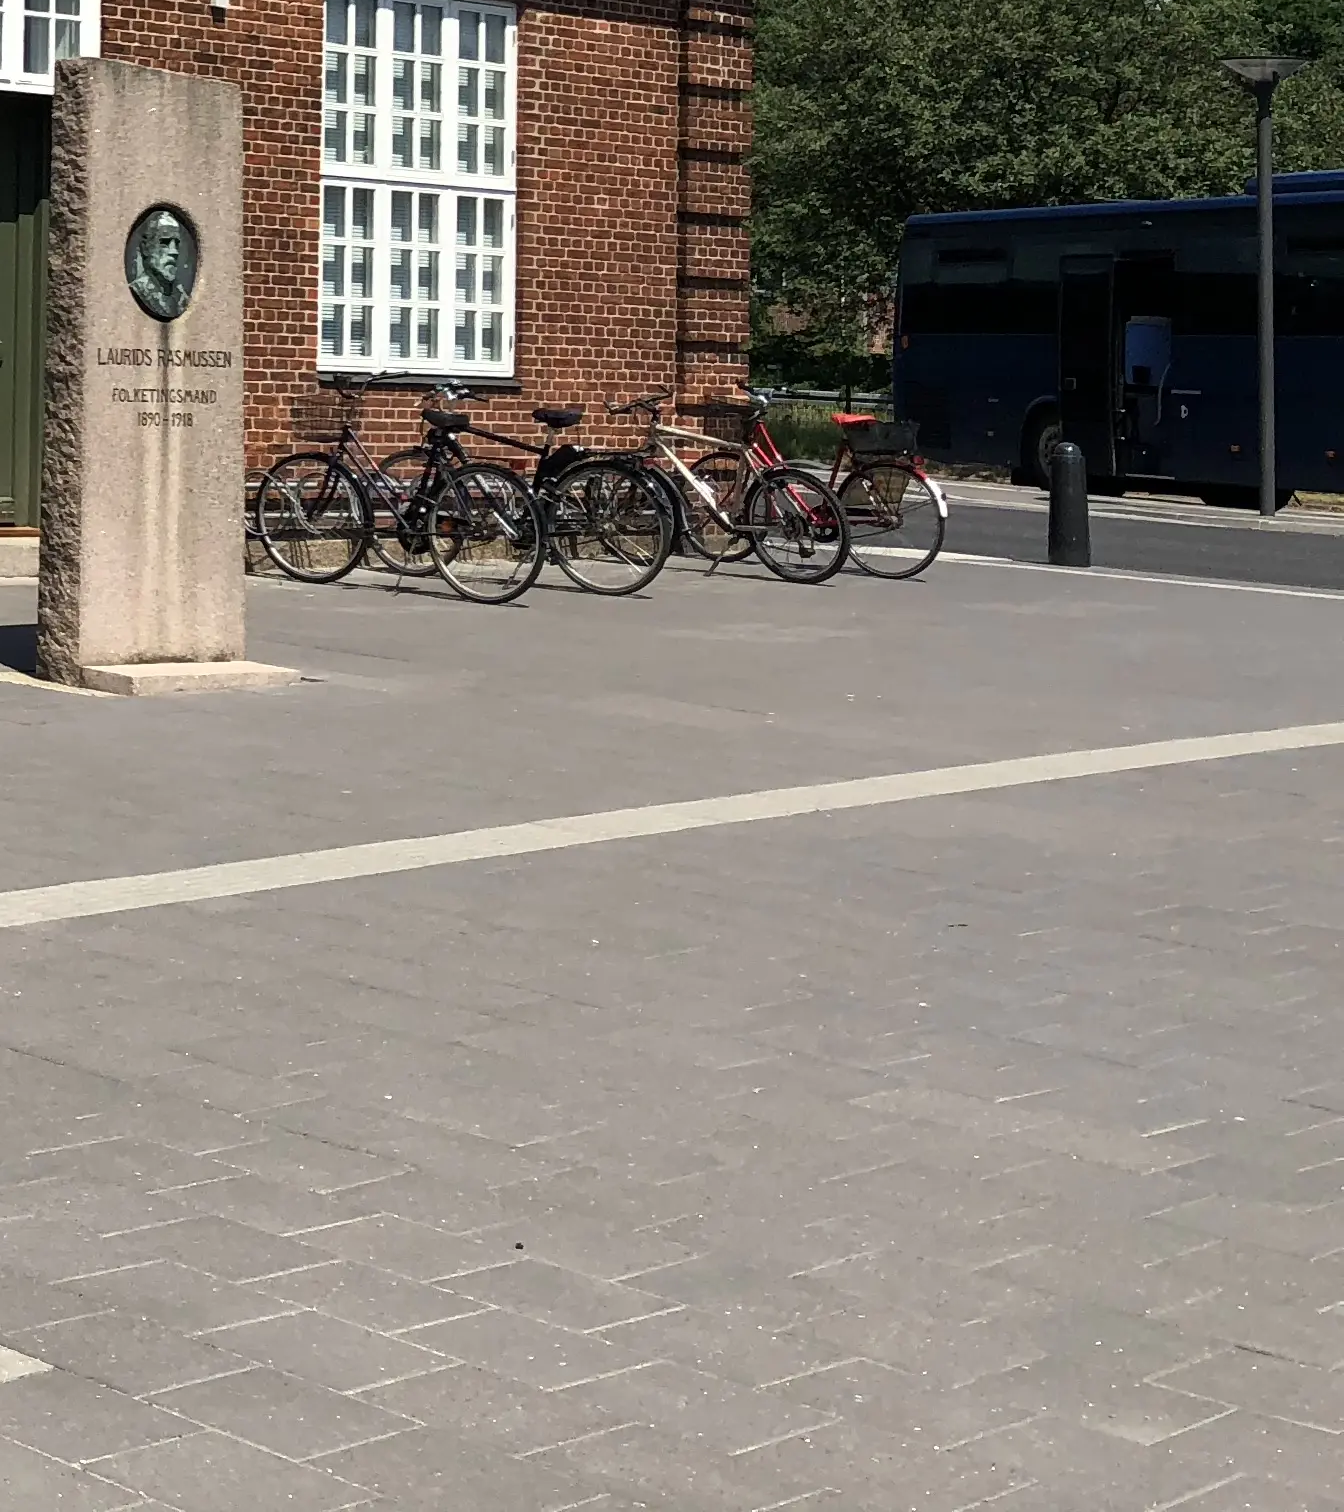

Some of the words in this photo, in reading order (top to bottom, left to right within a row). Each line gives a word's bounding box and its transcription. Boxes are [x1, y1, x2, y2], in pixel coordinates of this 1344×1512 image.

[97, 348, 152, 366] LAURIDS
[157, 349, 232, 368] RASMUSSEN
[112, 388, 217, 404] FOLKETINGSMAND
